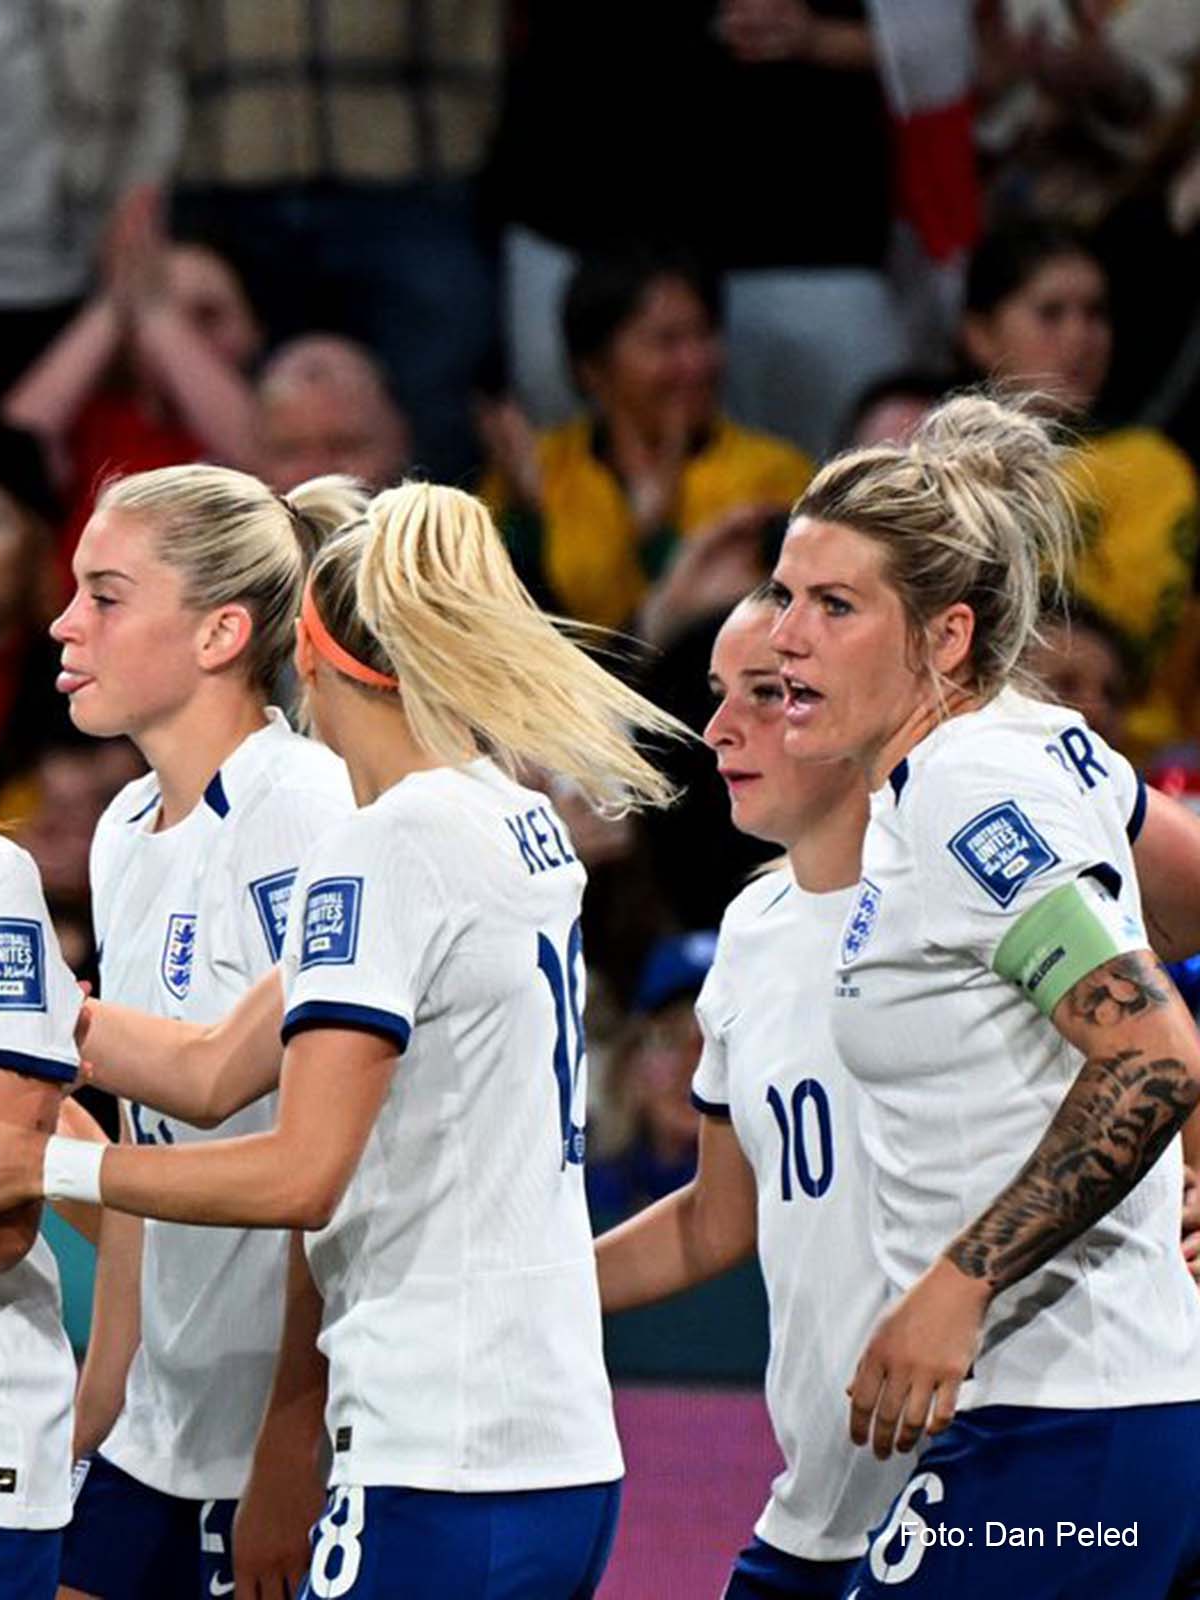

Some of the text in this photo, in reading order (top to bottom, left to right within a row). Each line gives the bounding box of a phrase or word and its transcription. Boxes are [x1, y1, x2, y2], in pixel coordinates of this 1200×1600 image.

[966, 817, 1013, 849] FOOTBALL
[974, 831, 1019, 864] UNITES
[3, 962, 36, 979] World
[766, 1078, 834, 1202] 10
[309, 1486, 364, 1598] 8
[869, 1471, 944, 1584] 6
